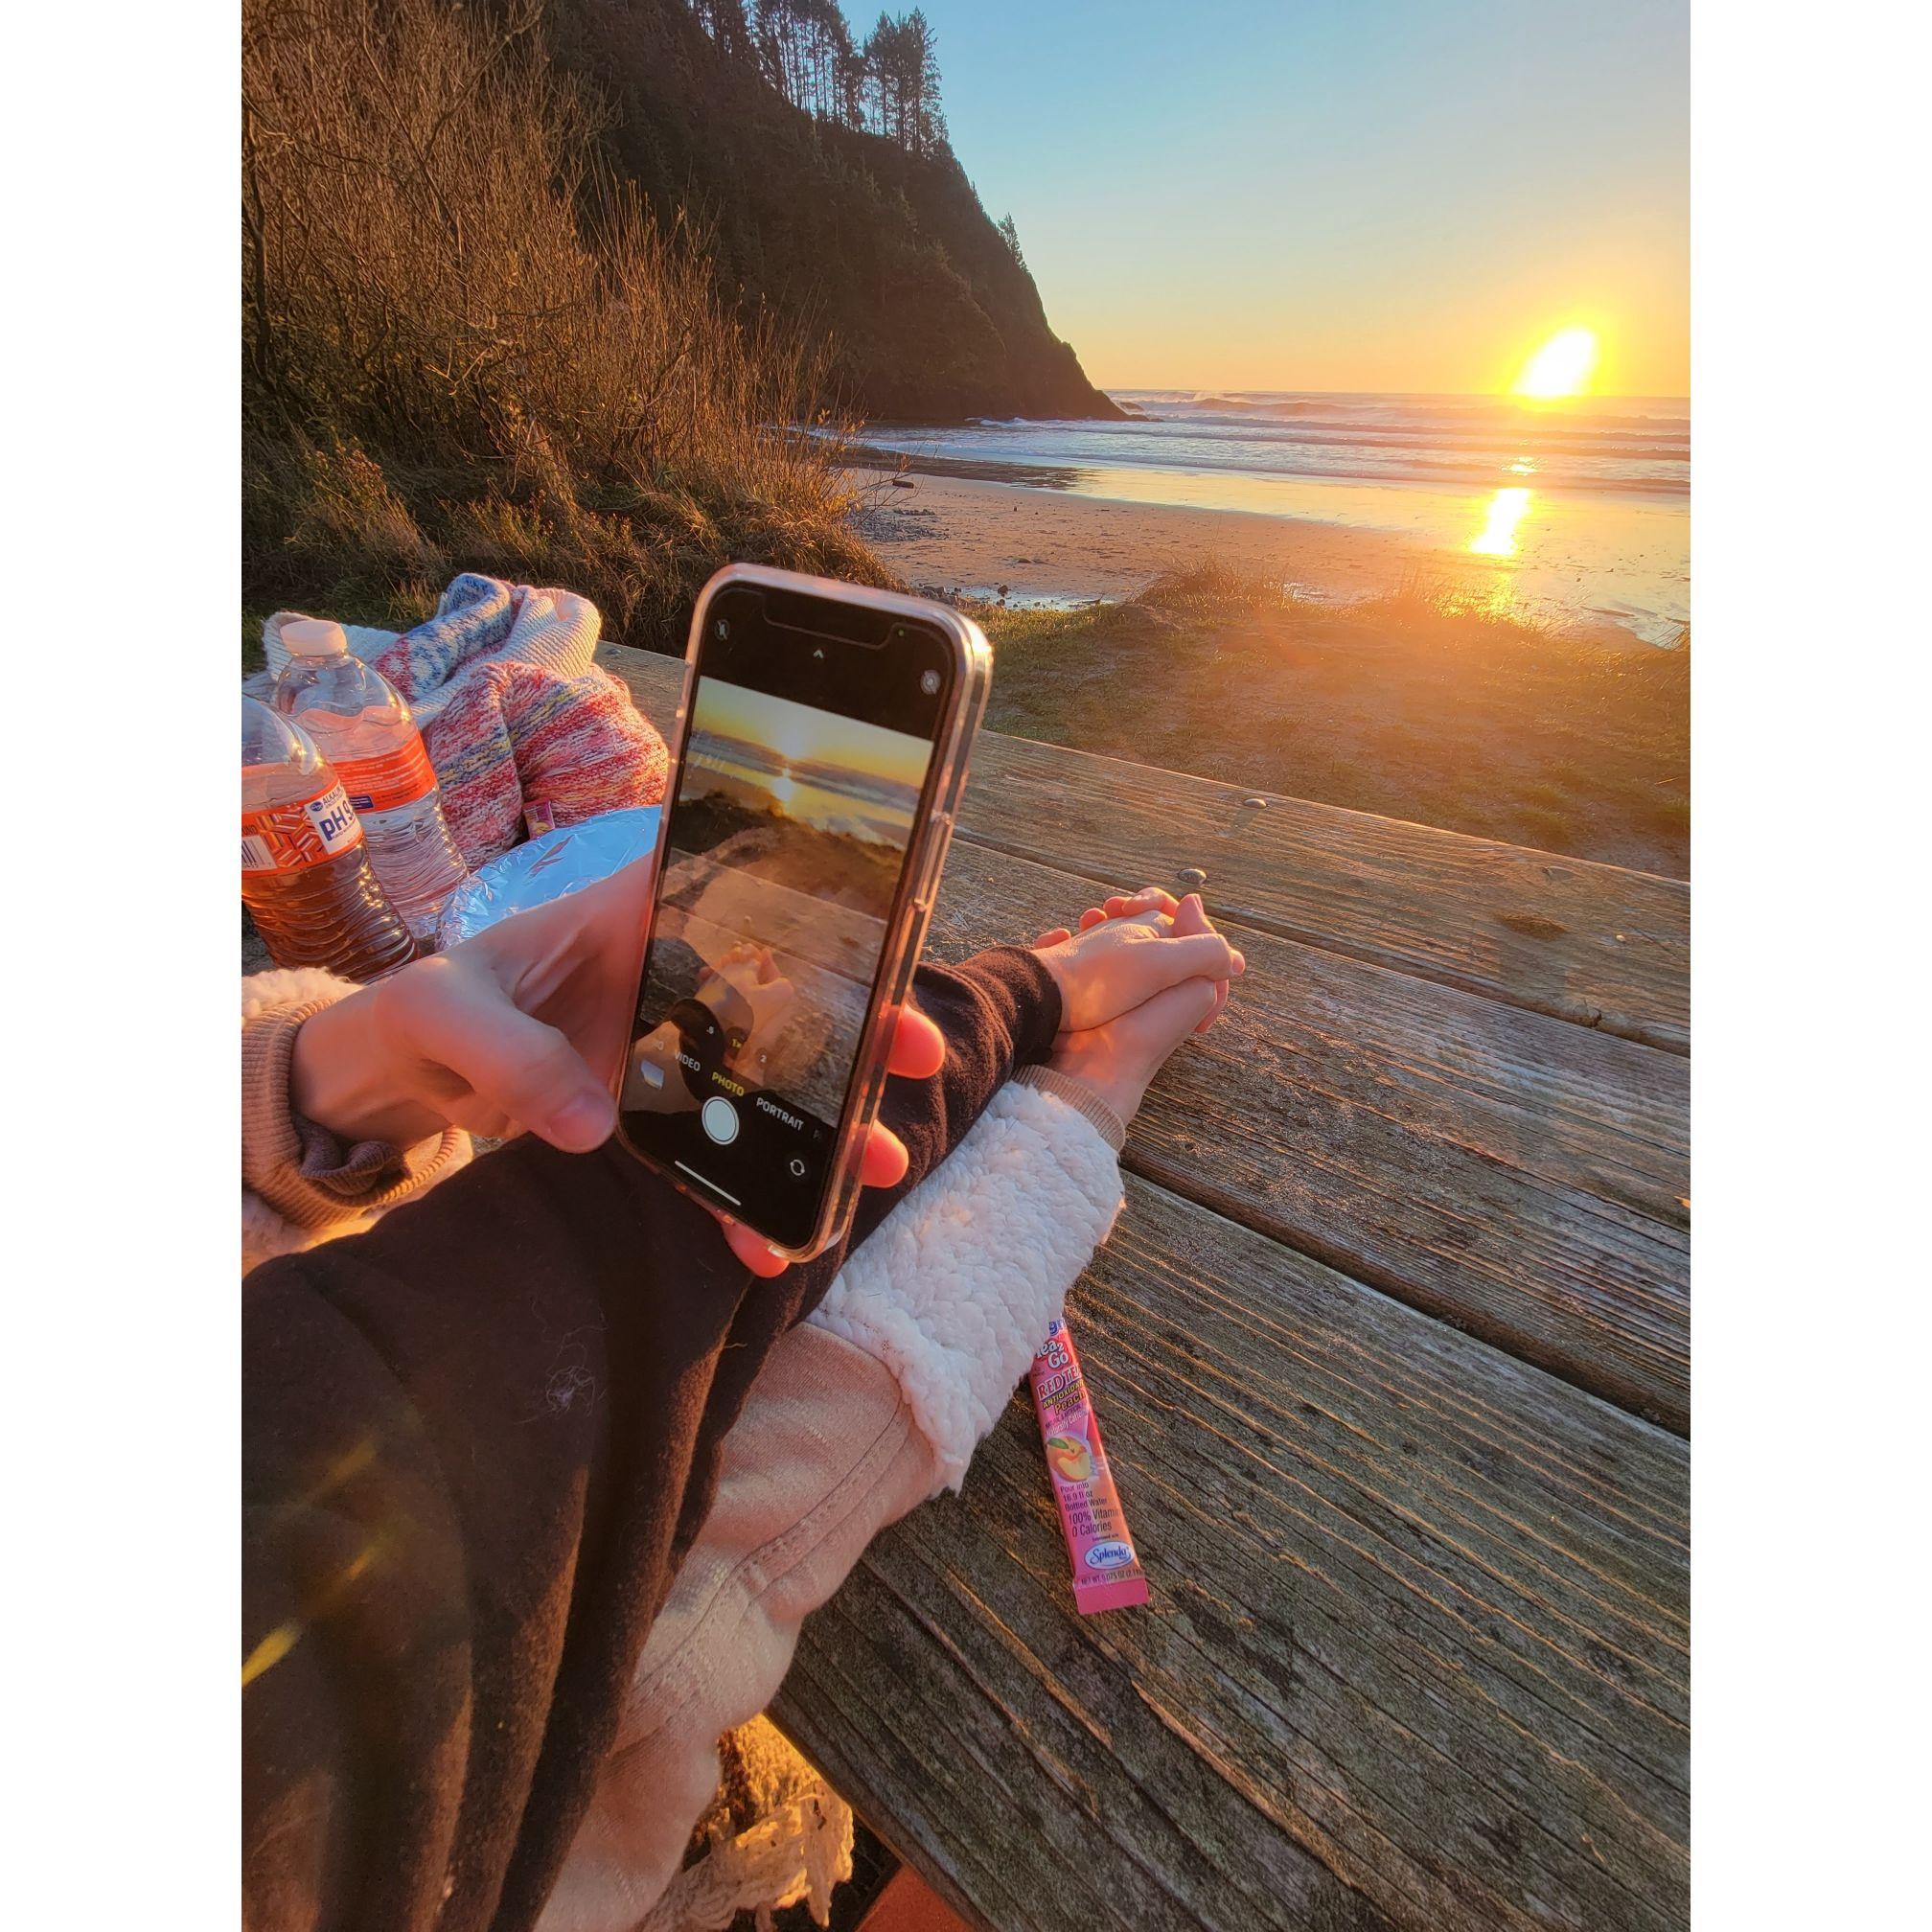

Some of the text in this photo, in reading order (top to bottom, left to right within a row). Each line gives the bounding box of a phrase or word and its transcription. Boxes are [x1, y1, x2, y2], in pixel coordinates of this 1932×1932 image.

[675, 1051, 805, 1131] VIDEO PHOTO PORTRAIT
[1047, 1351, 1070, 1368] Go
[1037, 1374, 1064, 1400] RED
[1054, 1388, 1086, 1415] Peach
[1065, 1498, 1107, 1511] Bottled Water
[1070, 1511, 1091, 1526] 100%
[1072, 1526, 1077, 1537] 0
[1080, 1521, 1112, 1535] Calories
[1090, 1546, 1127, 1564] Splenda
